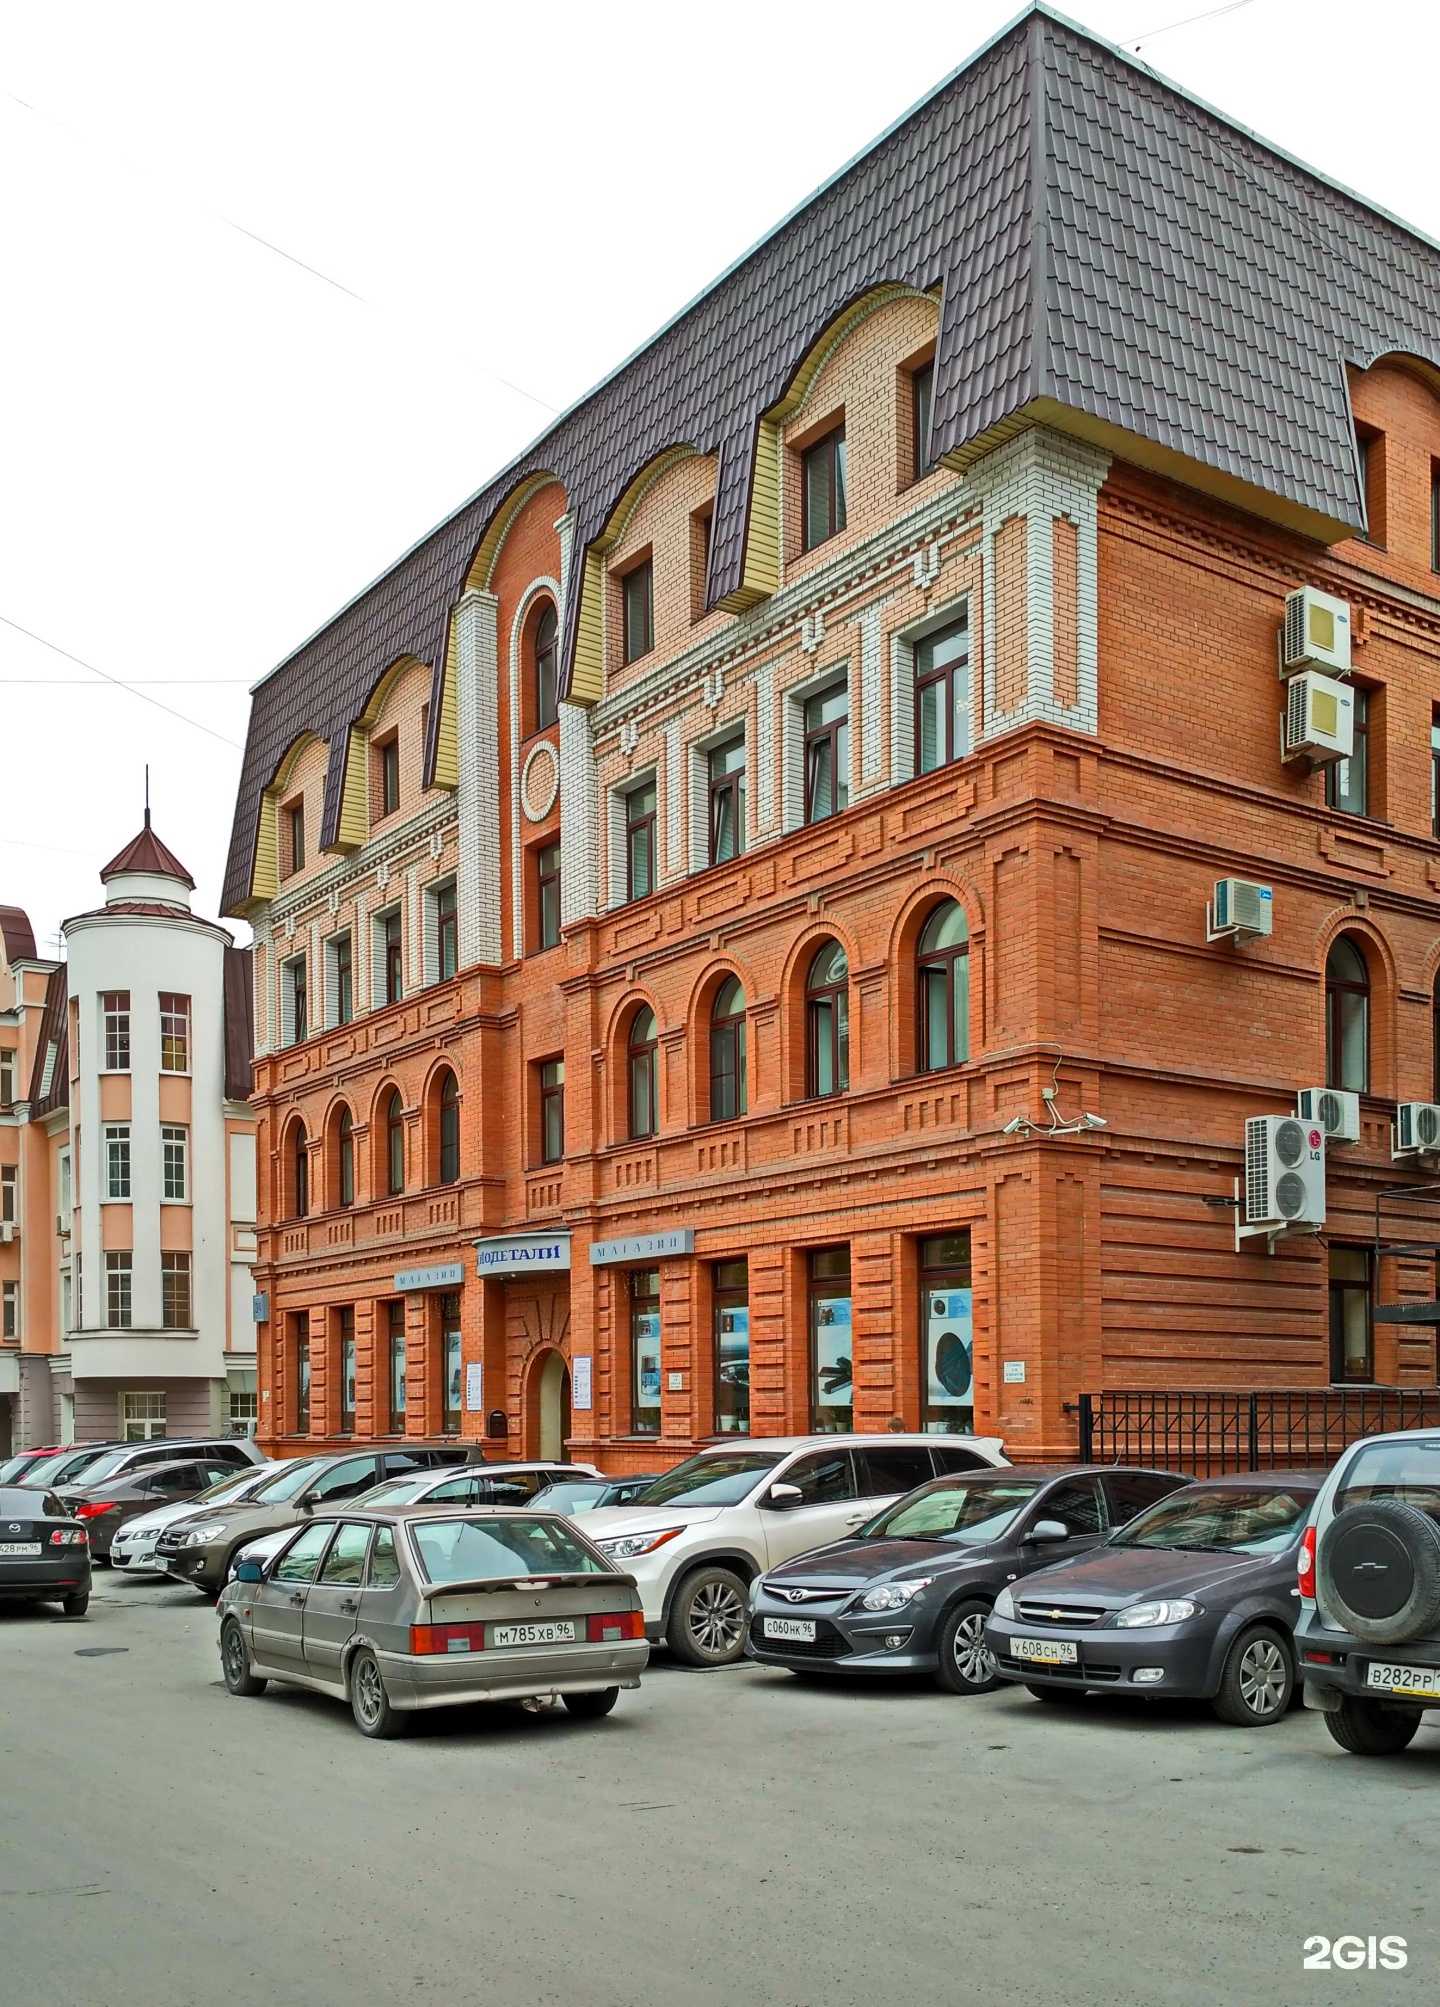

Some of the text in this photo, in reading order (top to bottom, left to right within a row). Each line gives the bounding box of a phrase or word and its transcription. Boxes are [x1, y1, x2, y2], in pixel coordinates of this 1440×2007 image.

[1310, 1151, 1320, 1161] LG
[598, 1237, 677, 1257] МАГАЗИН
[500, 1624, 570, 1644] М785ХВ 96
[802, 1622, 812, 1633] 96
[1060, 1643, 1072, 1655] 96
[1372, 1667, 1432, 1689] В282РР
